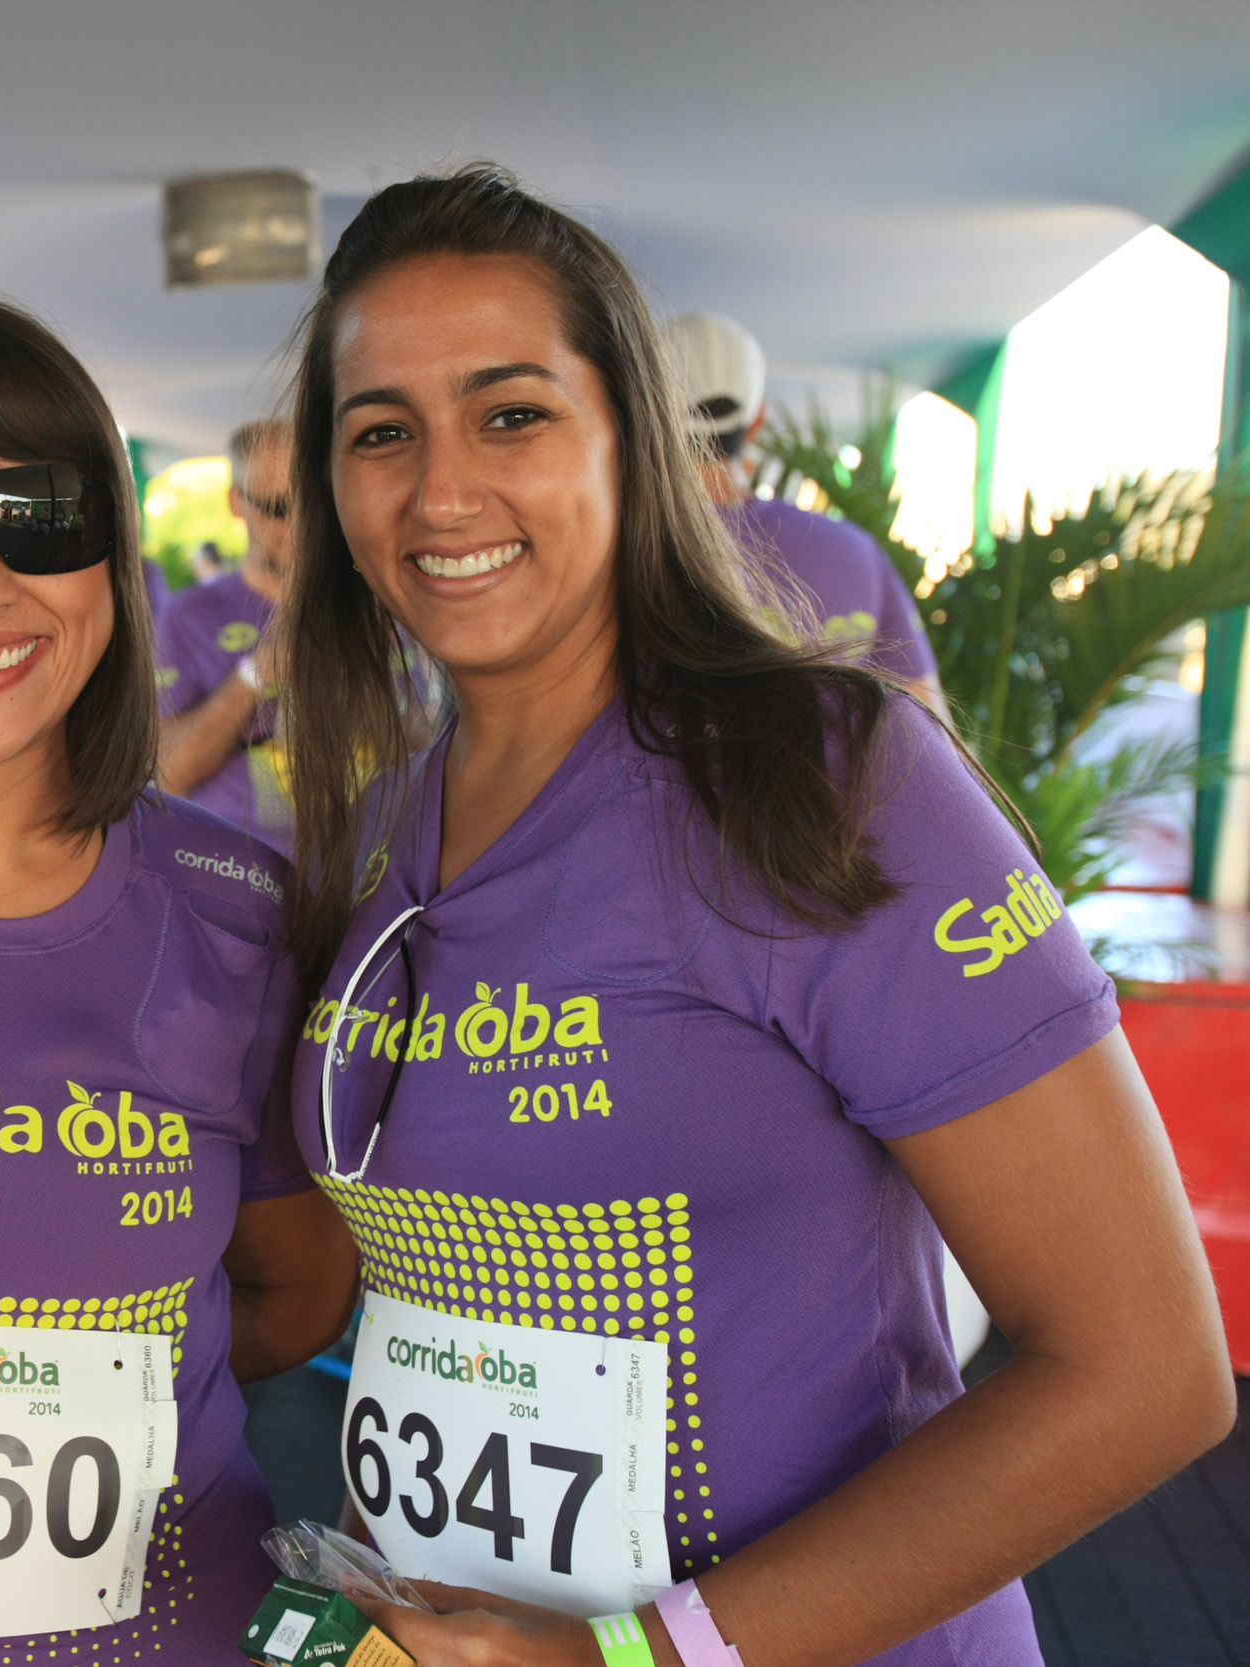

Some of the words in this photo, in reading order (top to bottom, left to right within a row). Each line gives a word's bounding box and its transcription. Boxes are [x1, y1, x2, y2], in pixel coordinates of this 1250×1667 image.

[175, 848, 245, 881] corrida
[248, 861, 284, 900] oba
[934, 868, 1062, 978] Sadia
[454, 981, 603, 1058] oba
[469, 1048, 609, 1074] HORTIFRUTI
[56, 1079, 191, 1159] oba
[508, 1079, 613, 1123] 2014
[77, 1158, 193, 1175] HORTIFRUTI
[120, 1186, 193, 1226] 2014
[144, 1345, 152, 1369] 6360
[387, 1335, 474, 1383] corrida
[474, 1341, 538, 1389] oba
[630, 1353, 641, 1379] 6347
[28, 1401, 61, 1416] 2014
[481, 1382, 539, 1399] HORTIFRUTI
[626, 1381, 634, 1416] GUARDA
[635, 1380, 644, 1420] VOLUMES
[509, 1402, 540, 1420] 2014
[145, 1425, 155, 1469] MEDALHA
[346, 1396, 603, 1576] 6347
[628, 1443, 637, 1492] MEDALHA
[126, 1570, 135, 1599] COCO
[314, 1646, 332, 1657] Tetra
[333, 1641, 347, 1653] Pak
